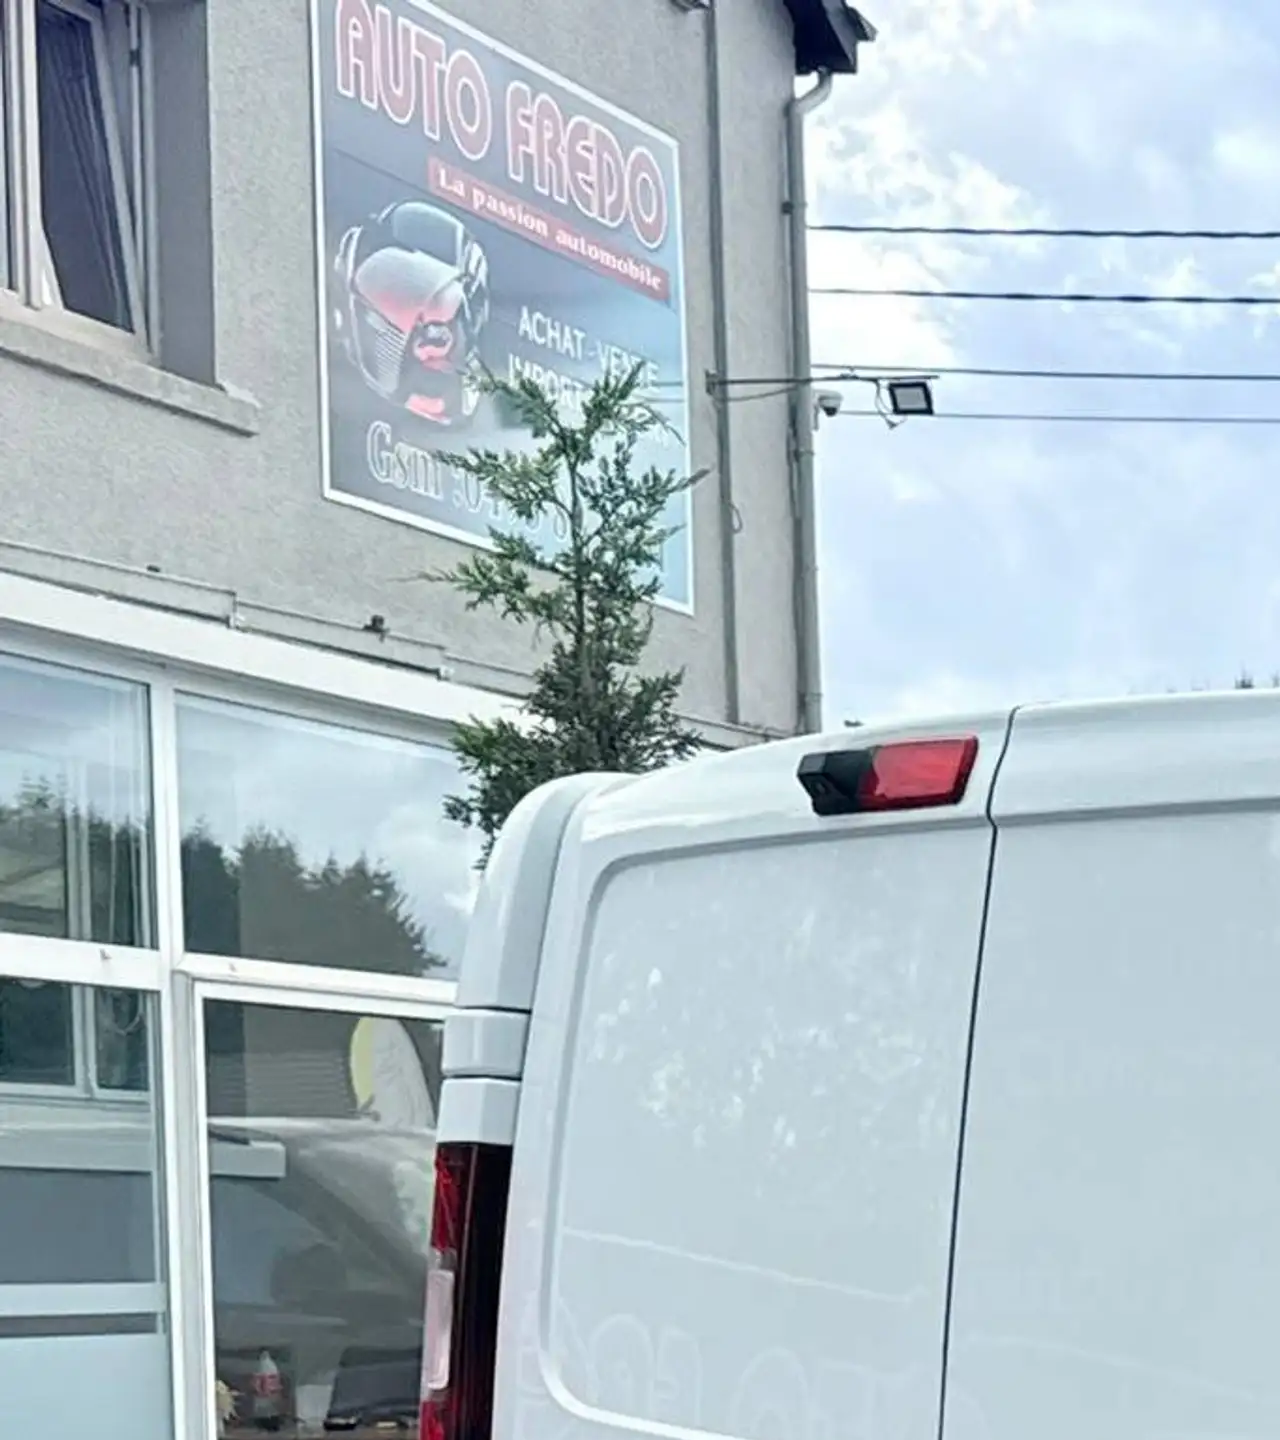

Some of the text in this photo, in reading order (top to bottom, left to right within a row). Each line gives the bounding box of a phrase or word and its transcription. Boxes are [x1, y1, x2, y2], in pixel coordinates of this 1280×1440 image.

[336, 0, 667, 250] AUTO FREDO
[438, 167, 662, 292] La passion automobile
[518, 305, 587, 361] ACHAT
[366, 420, 444, 500] Gsm
